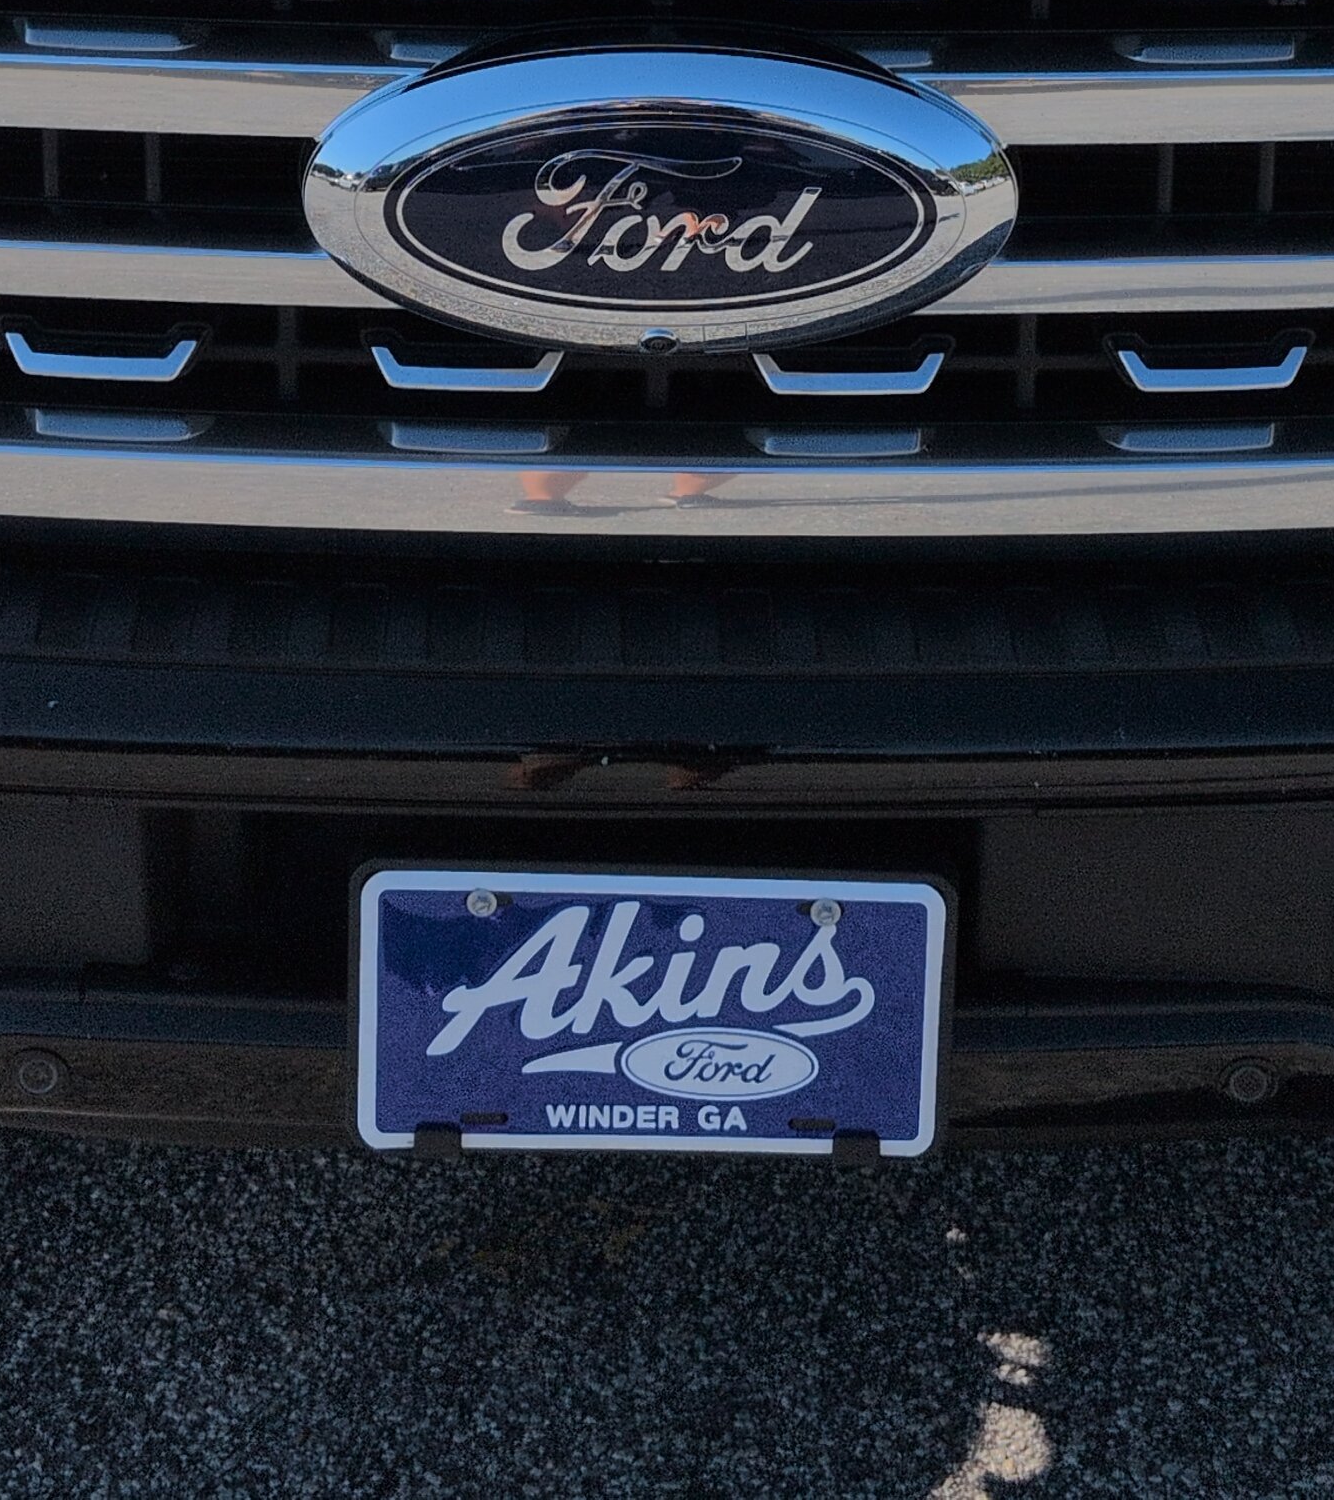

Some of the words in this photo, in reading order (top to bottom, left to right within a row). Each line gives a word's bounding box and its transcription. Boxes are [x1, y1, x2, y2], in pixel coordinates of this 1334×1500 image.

[502, 148, 822, 272] Ford
[426, 901, 875, 1056] Akins
[663, 1040, 774, 1084] Ford
[546, 1104, 680, 1130] WINDER
[697, 1104, 748, 1131] GA
